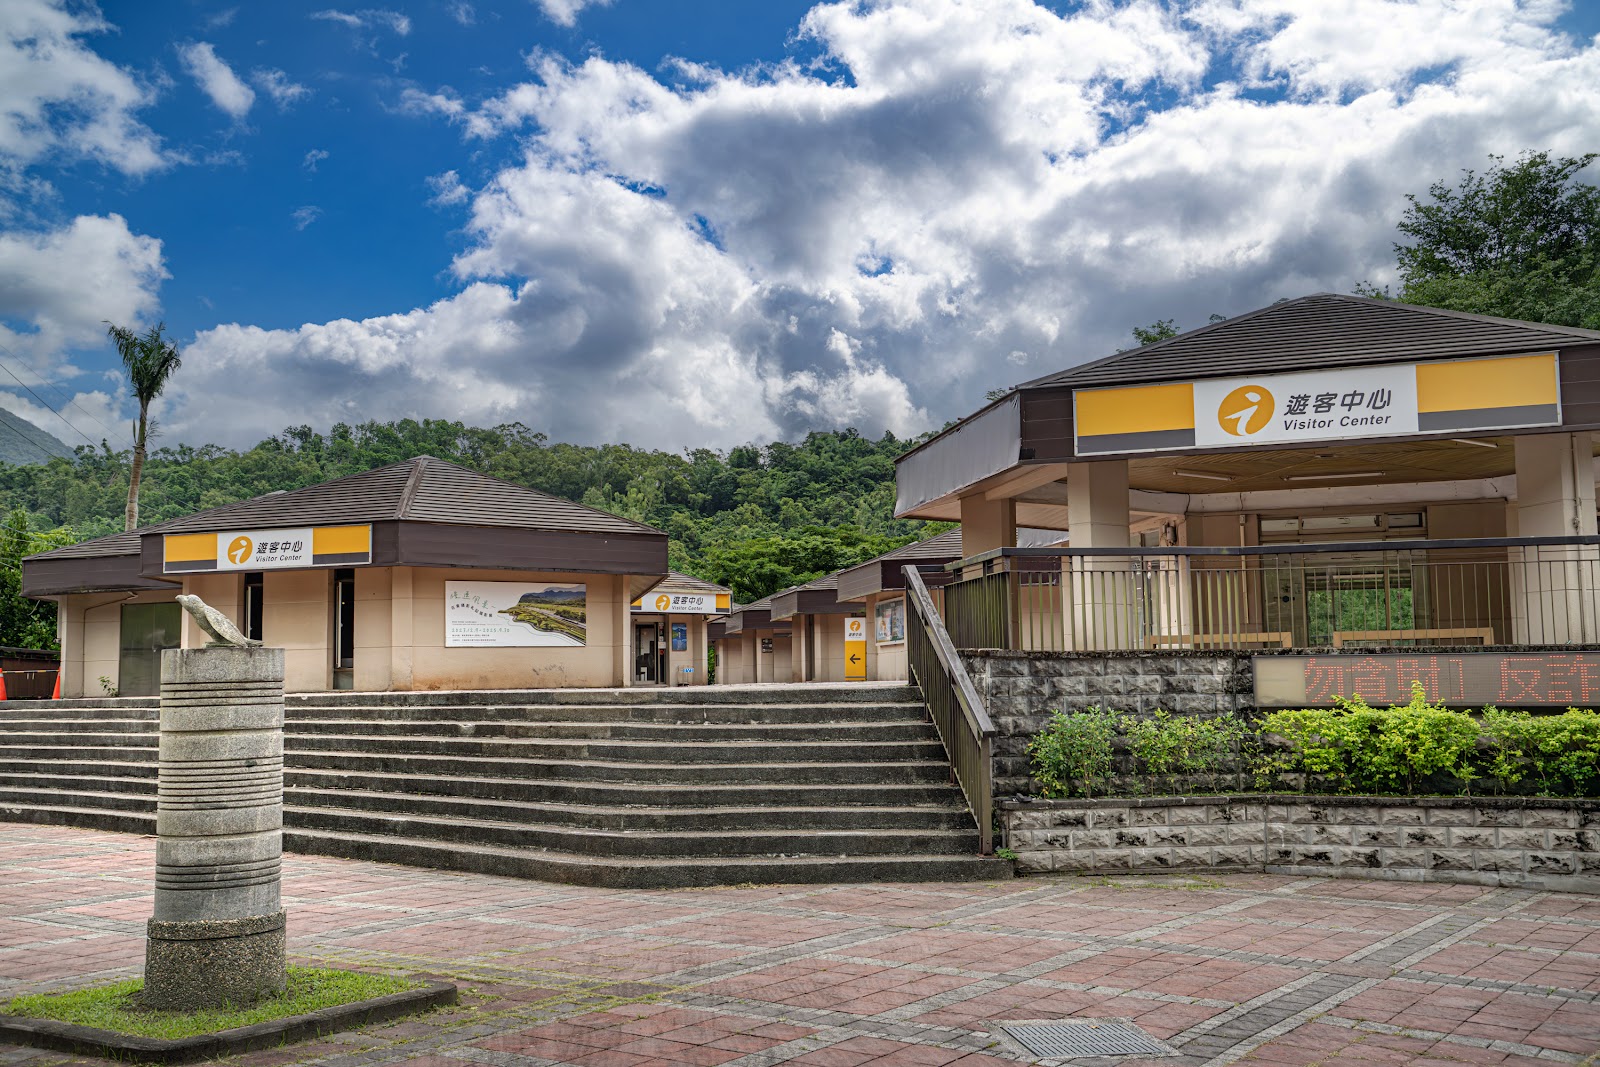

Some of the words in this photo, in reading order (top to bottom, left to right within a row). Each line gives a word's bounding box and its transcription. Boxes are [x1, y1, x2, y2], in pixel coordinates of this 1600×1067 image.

[1284, 388, 1392, 416] 遊客中心
[1284, 418, 1334, 431] Visitor
[1340, 415, 1392, 427] Center
[256, 541, 302, 554] 遊客中心
[672, 596, 703, 605] 遊客中心
